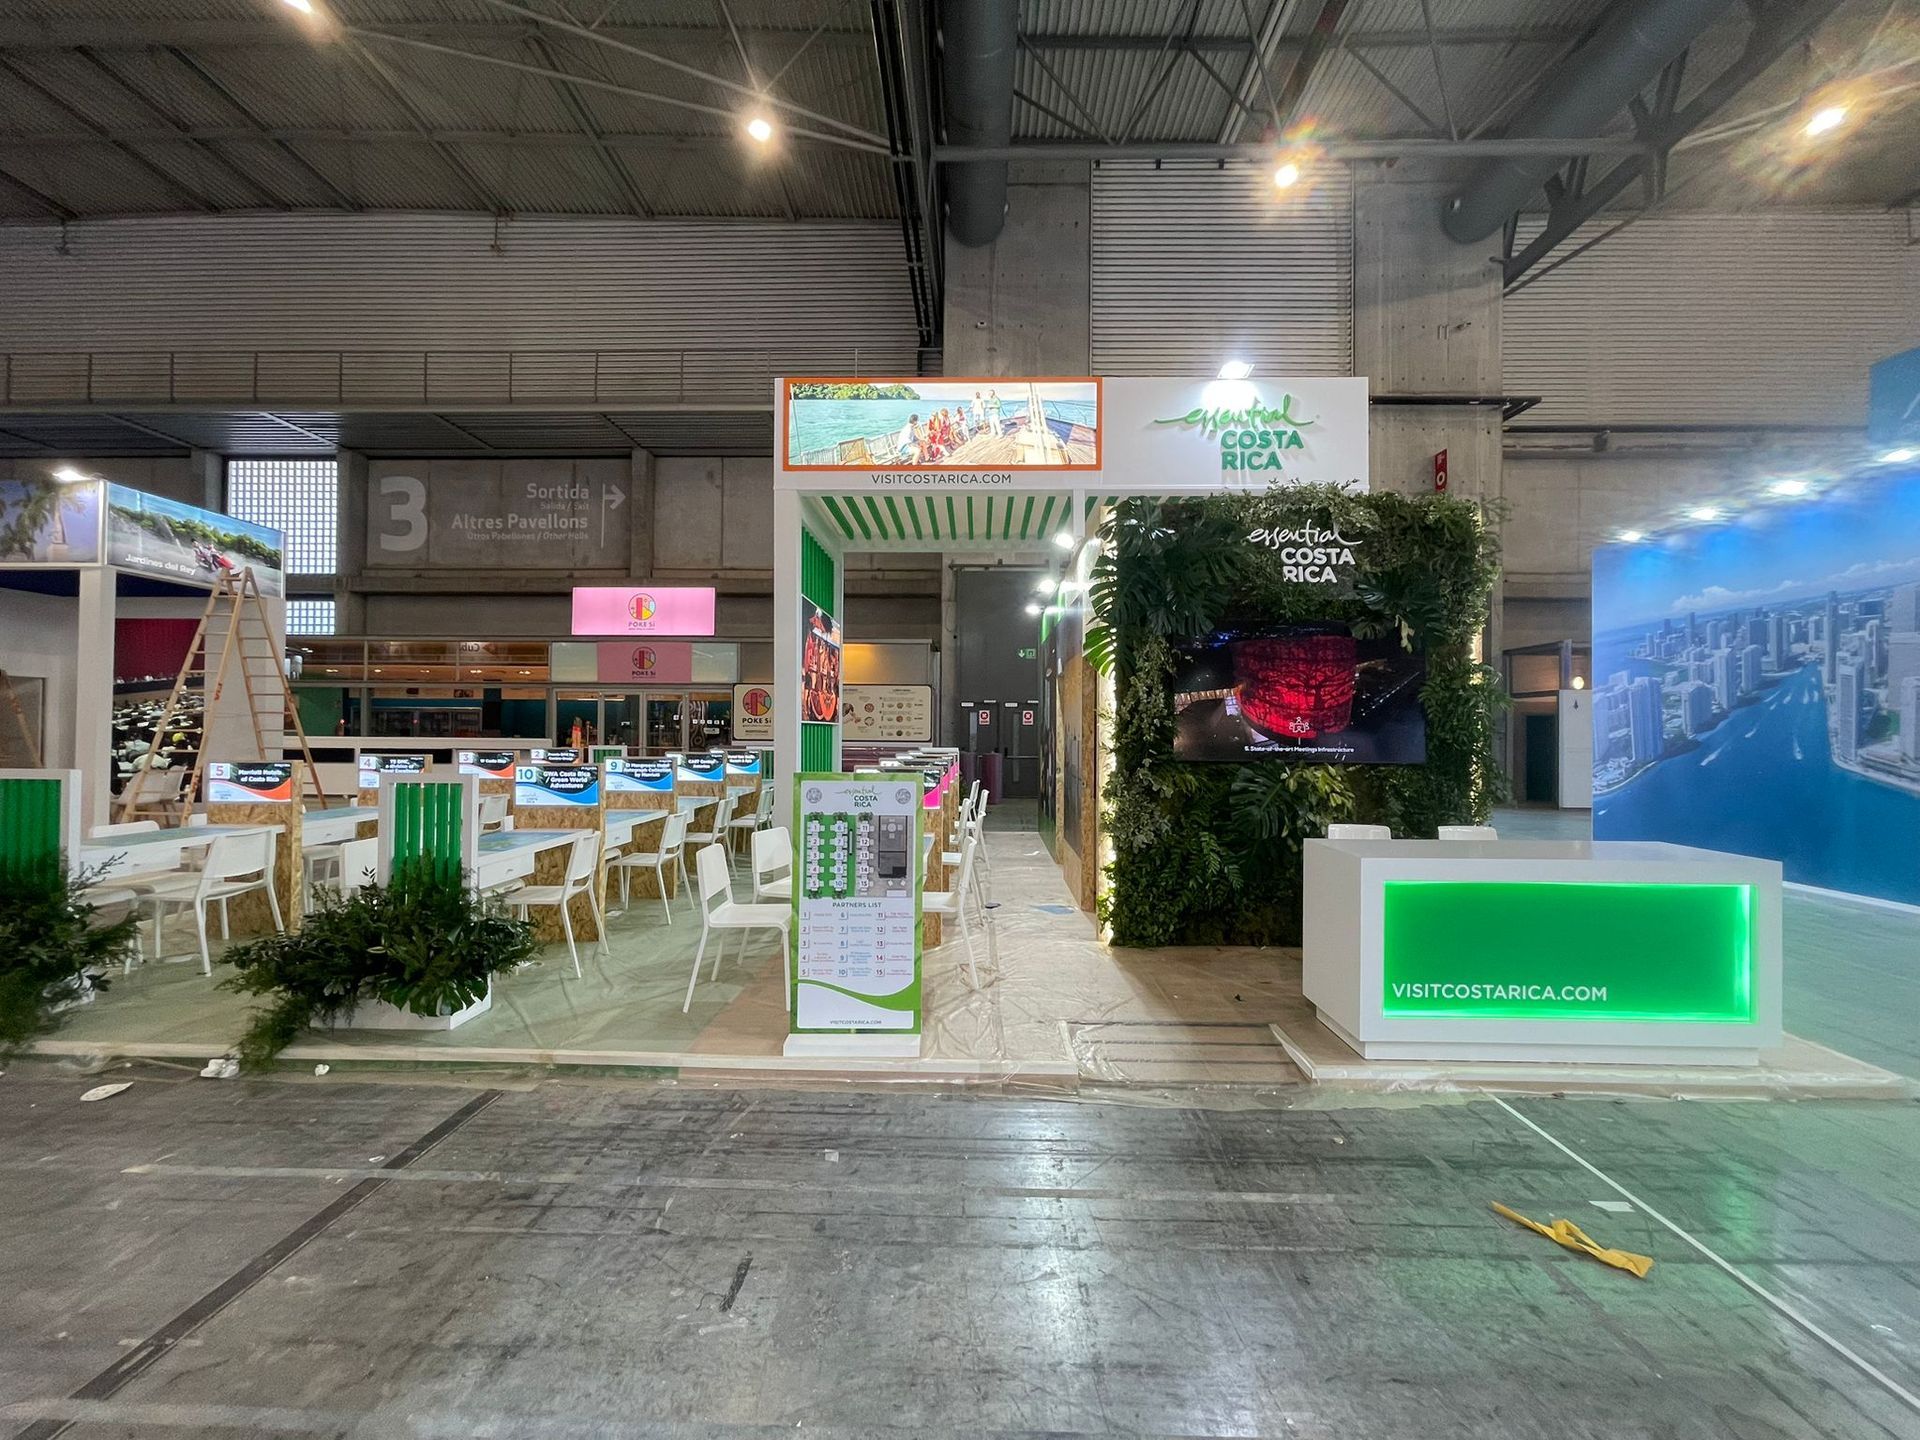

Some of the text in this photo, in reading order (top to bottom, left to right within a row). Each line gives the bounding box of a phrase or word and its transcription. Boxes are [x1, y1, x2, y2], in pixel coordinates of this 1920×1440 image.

[1154, 394, 1315, 432] essential
[1221, 430, 1304, 450] COSTA
[1222, 451, 1283, 471] RICA
[871, 473, 1012, 485] VISITCOSTARICA.COM
[526, 482, 590, 500] Sortida
[379, 475, 428, 551] 3
[451, 513, 588, 530] Altres Pavellons
[543, 531, 567, 541] Other
[1248, 518, 1364, 550] essential
[125, 553, 196, 576] Jardines del Rey
[1281, 547, 1355, 566] COSTA
[1283, 566, 1338, 584] RICA
[364, 758, 371, 767] 4
[463, 753, 469, 761] 3
[610, 761, 618, 771] 9
[215, 765, 224, 776] 5
[517, 768, 534, 780] 10
[1391, 982, 1608, 1001] VISITCOSTARICA.COM
